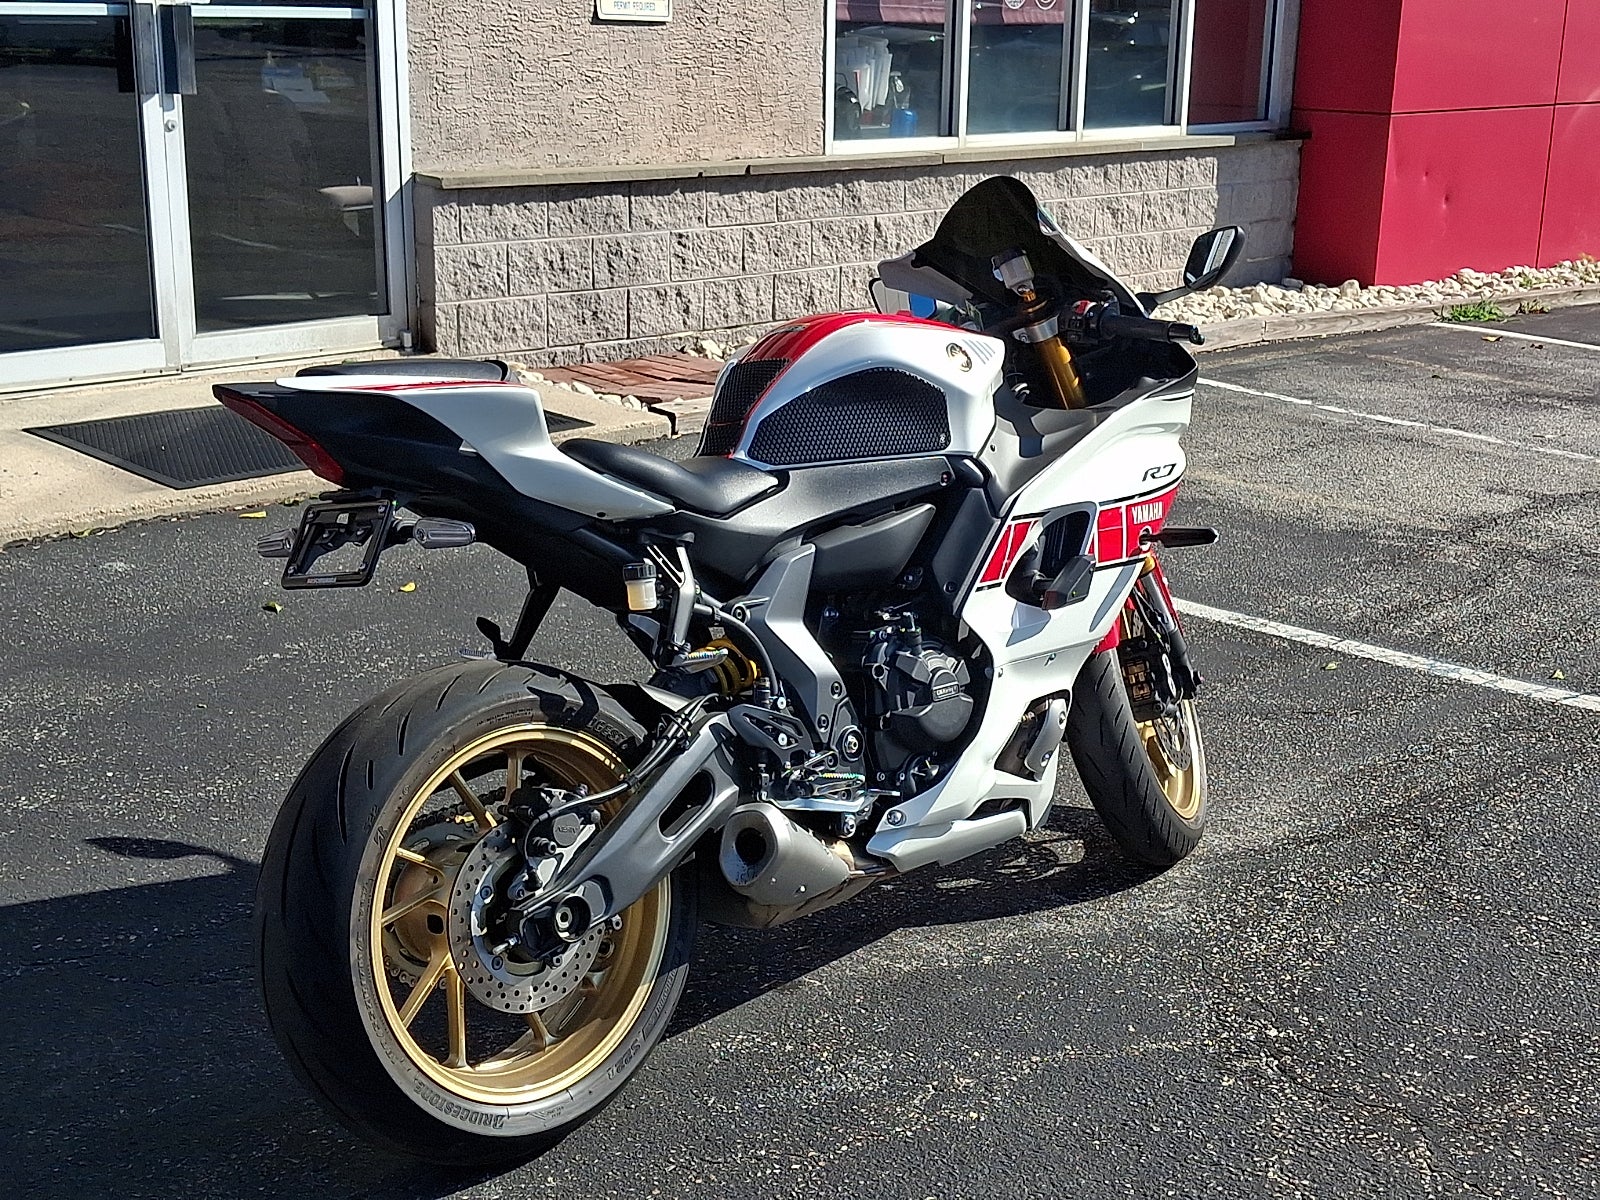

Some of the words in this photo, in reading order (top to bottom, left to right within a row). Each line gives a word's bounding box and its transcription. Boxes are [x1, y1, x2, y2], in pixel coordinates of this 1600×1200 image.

[613, 1, 631, 9] PERMIT
[632, 2, 656, 11] REQUIRED
[1131, 501, 1164, 525] YAMAHA
[413, 1081, 507, 1130] BRIDGESTONE
